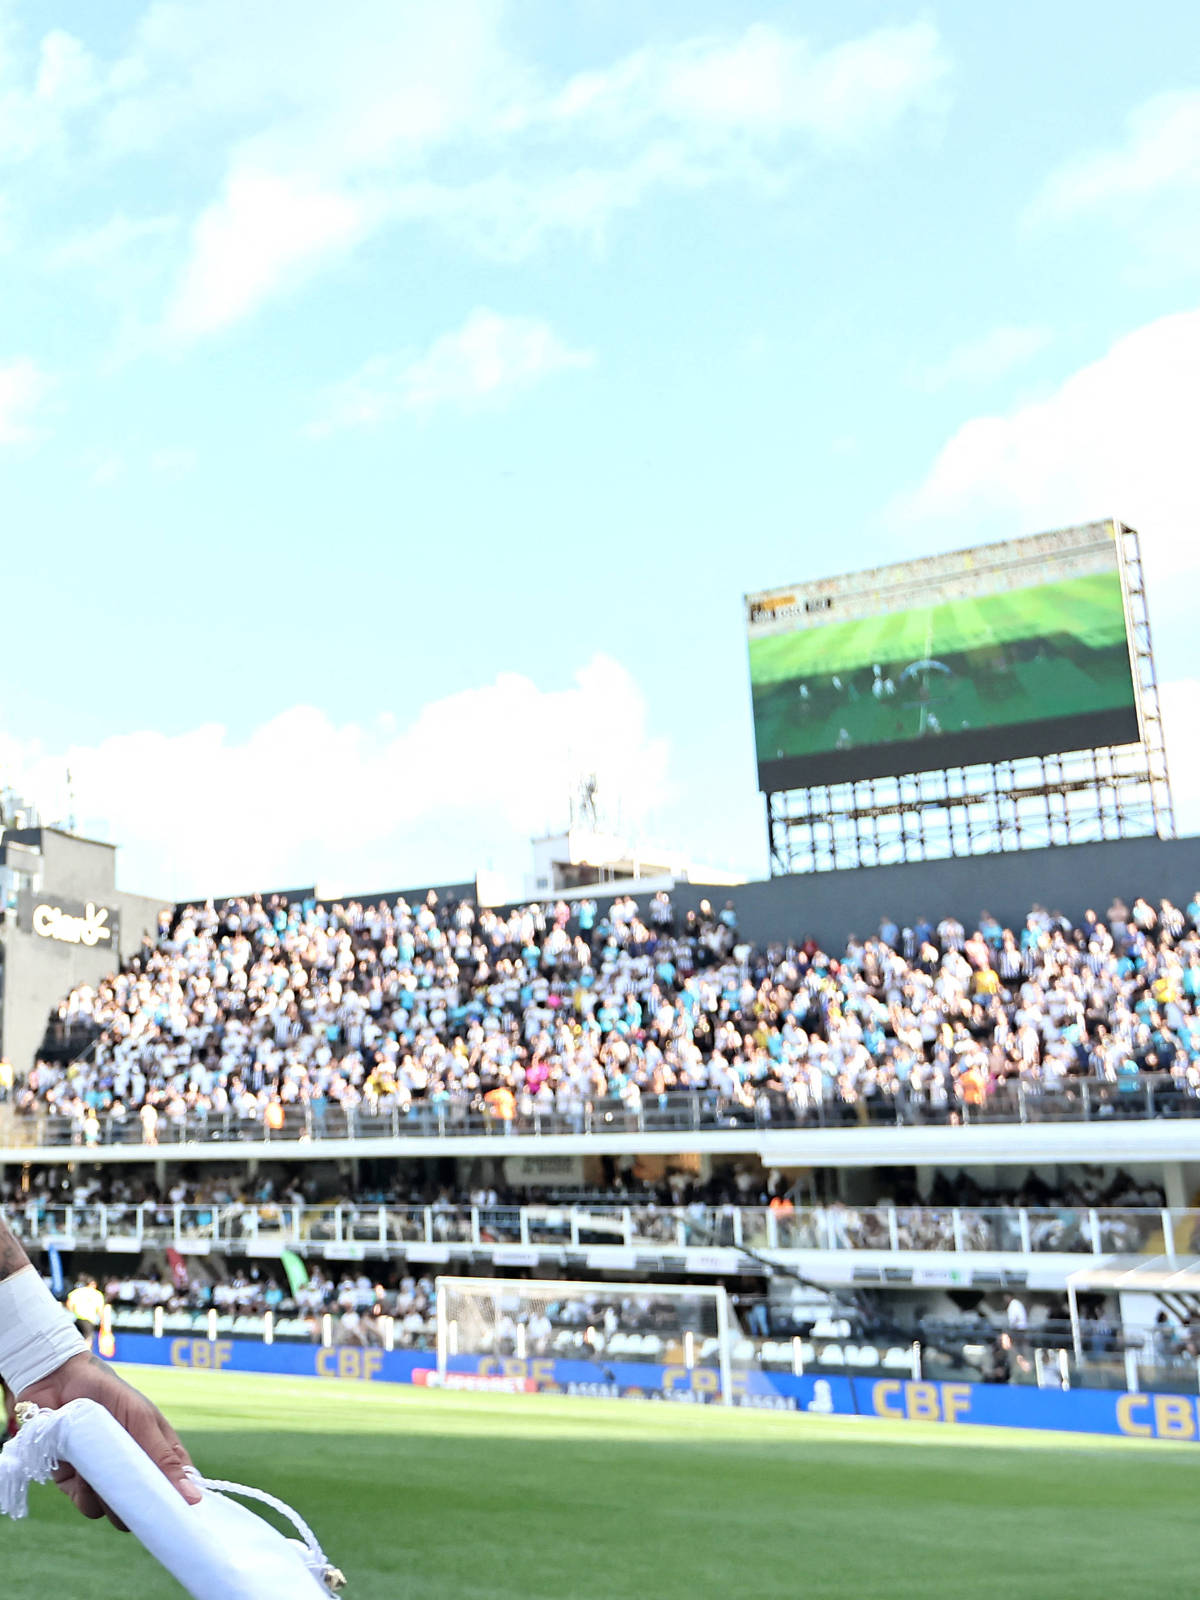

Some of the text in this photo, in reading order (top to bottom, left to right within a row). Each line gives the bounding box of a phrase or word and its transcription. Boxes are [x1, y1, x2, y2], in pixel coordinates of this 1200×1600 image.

[170, 1338, 234, 1369] CBF
[315, 1346, 383, 1379] CBF
[872, 1379, 973, 1423] CBF
[1115, 1393, 1200, 1442] CB
